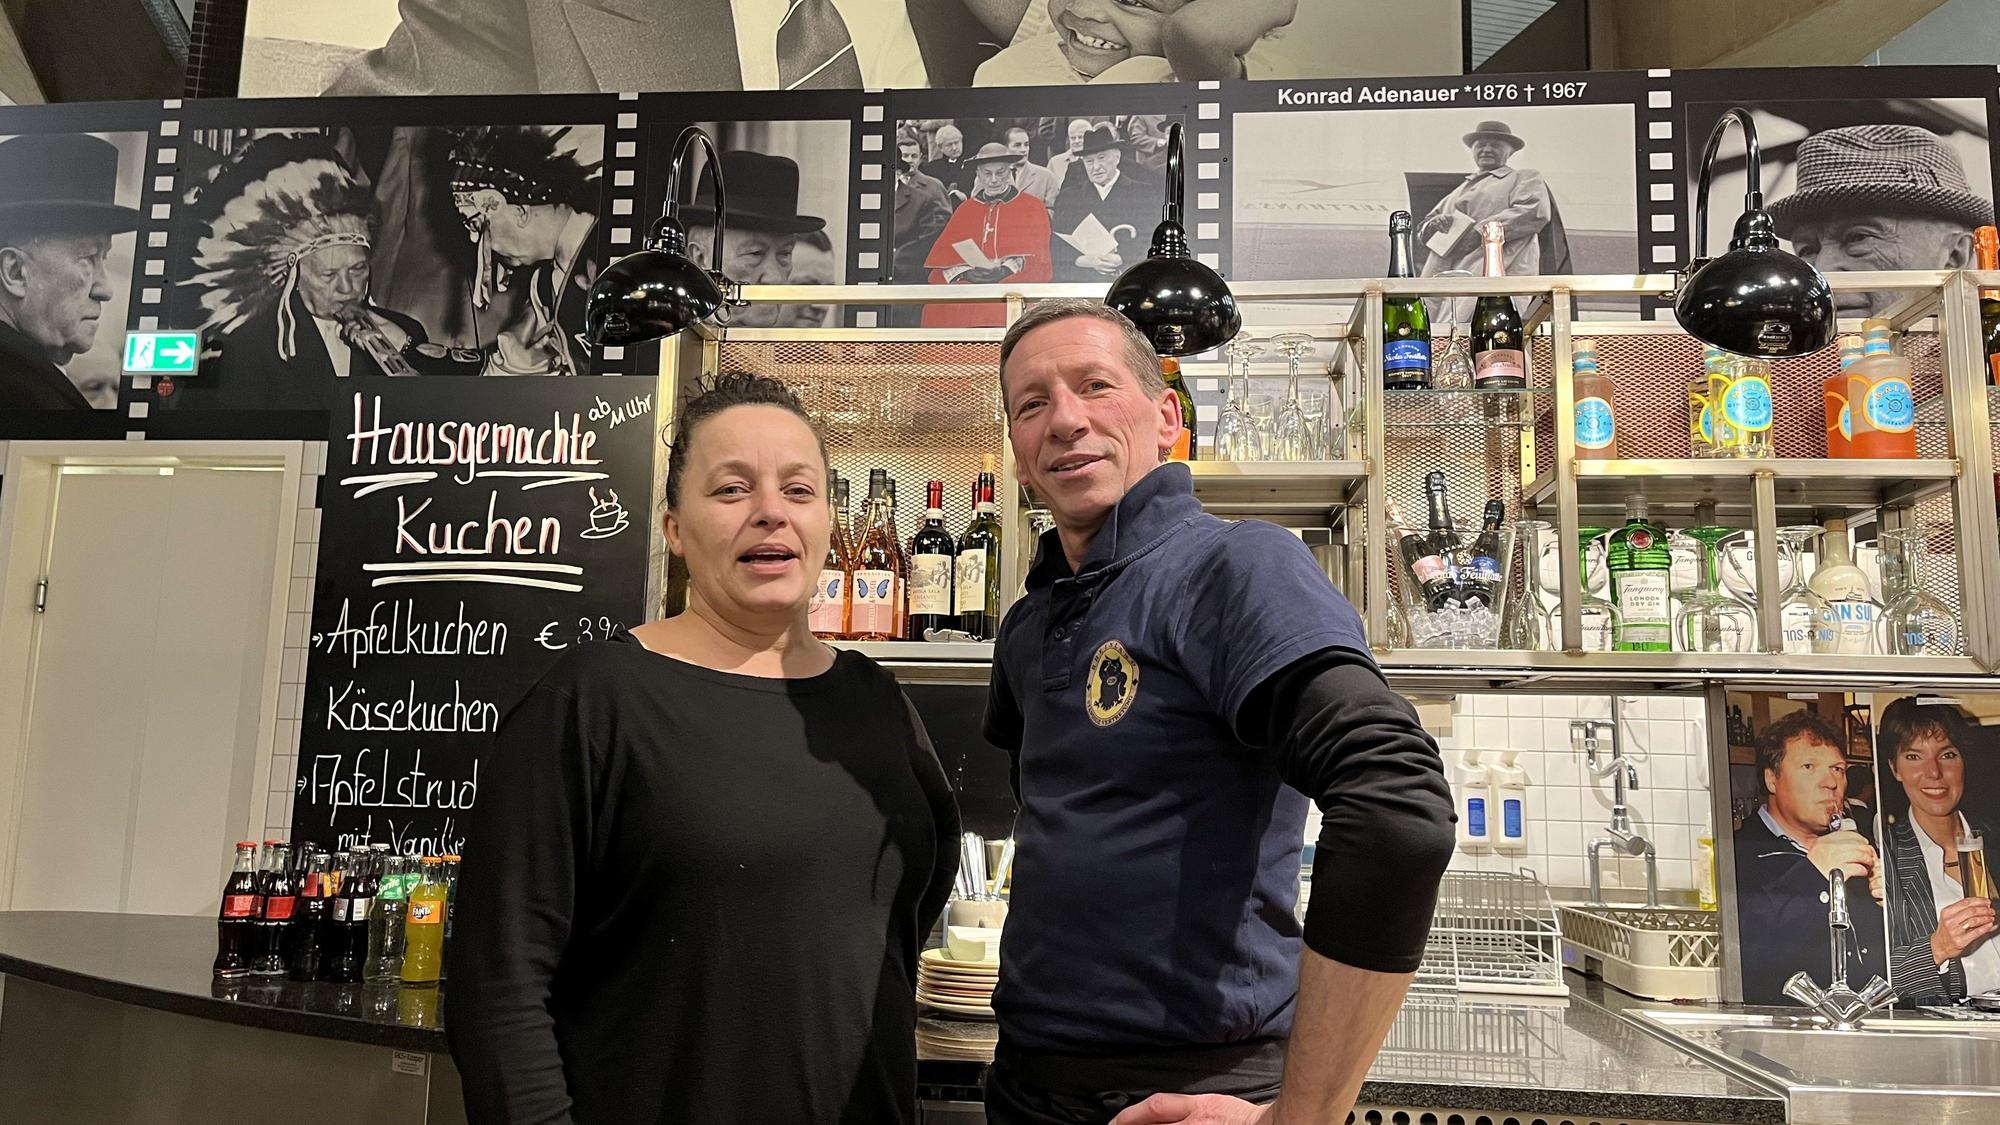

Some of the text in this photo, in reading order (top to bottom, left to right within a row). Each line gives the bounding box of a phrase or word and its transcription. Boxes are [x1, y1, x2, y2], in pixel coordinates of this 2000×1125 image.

[1277, 87, 1352, 105] Konrad
[1358, 86, 1458, 103] Adenauer
[1542, 82, 1588, 99] 1967
[588, 395, 611, 422] ab
[626, 393, 652, 419] Uhr
[346, 391, 603, 485] Hausgemachte
[395, 489, 561, 555] Kuchen
[327, 597, 508, 669] Apfelkuchen
[327, 679, 499, 733] Käsekuchen
[312, 748, 479, 826] Apfelstrud
[338, 815, 372, 851] mit
